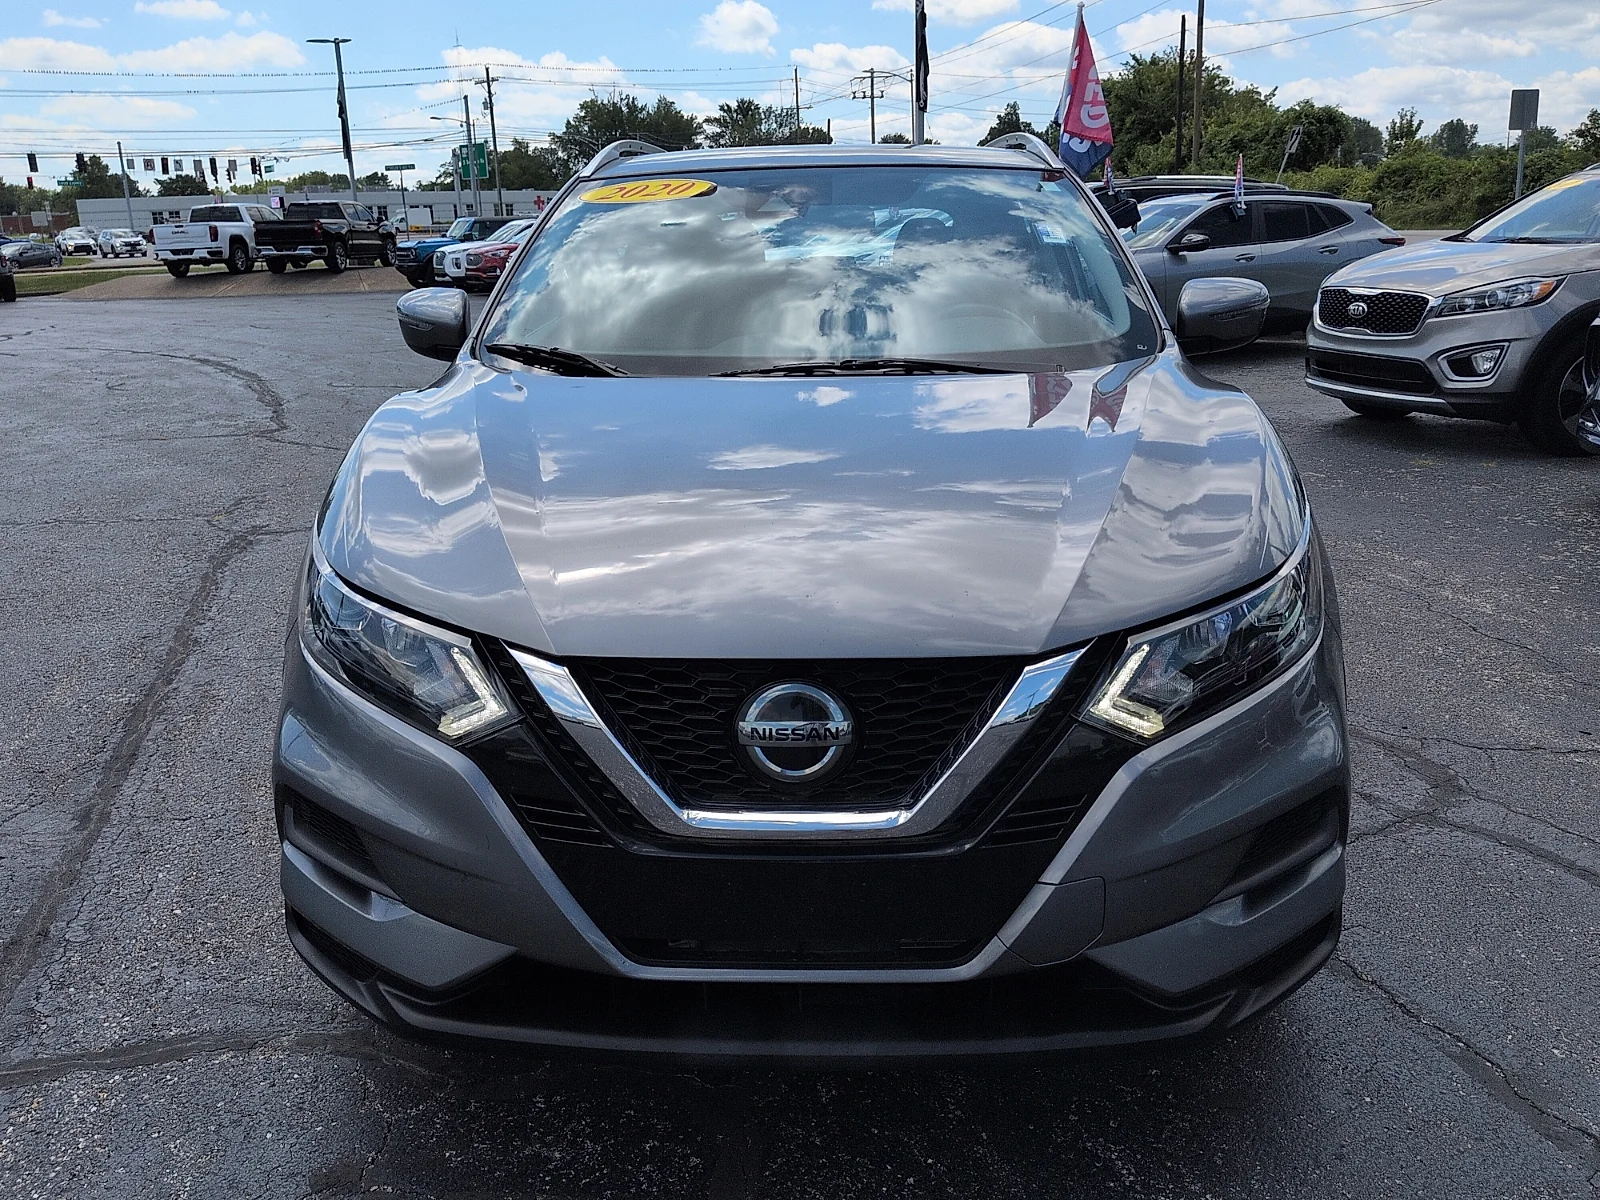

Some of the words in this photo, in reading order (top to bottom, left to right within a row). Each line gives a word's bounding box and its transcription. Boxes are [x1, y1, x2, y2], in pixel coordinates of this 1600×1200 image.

[595, 182, 695, 200] 2020
[1349, 306, 1363, 316] KIA
[750, 727, 839, 741] NISSAN
